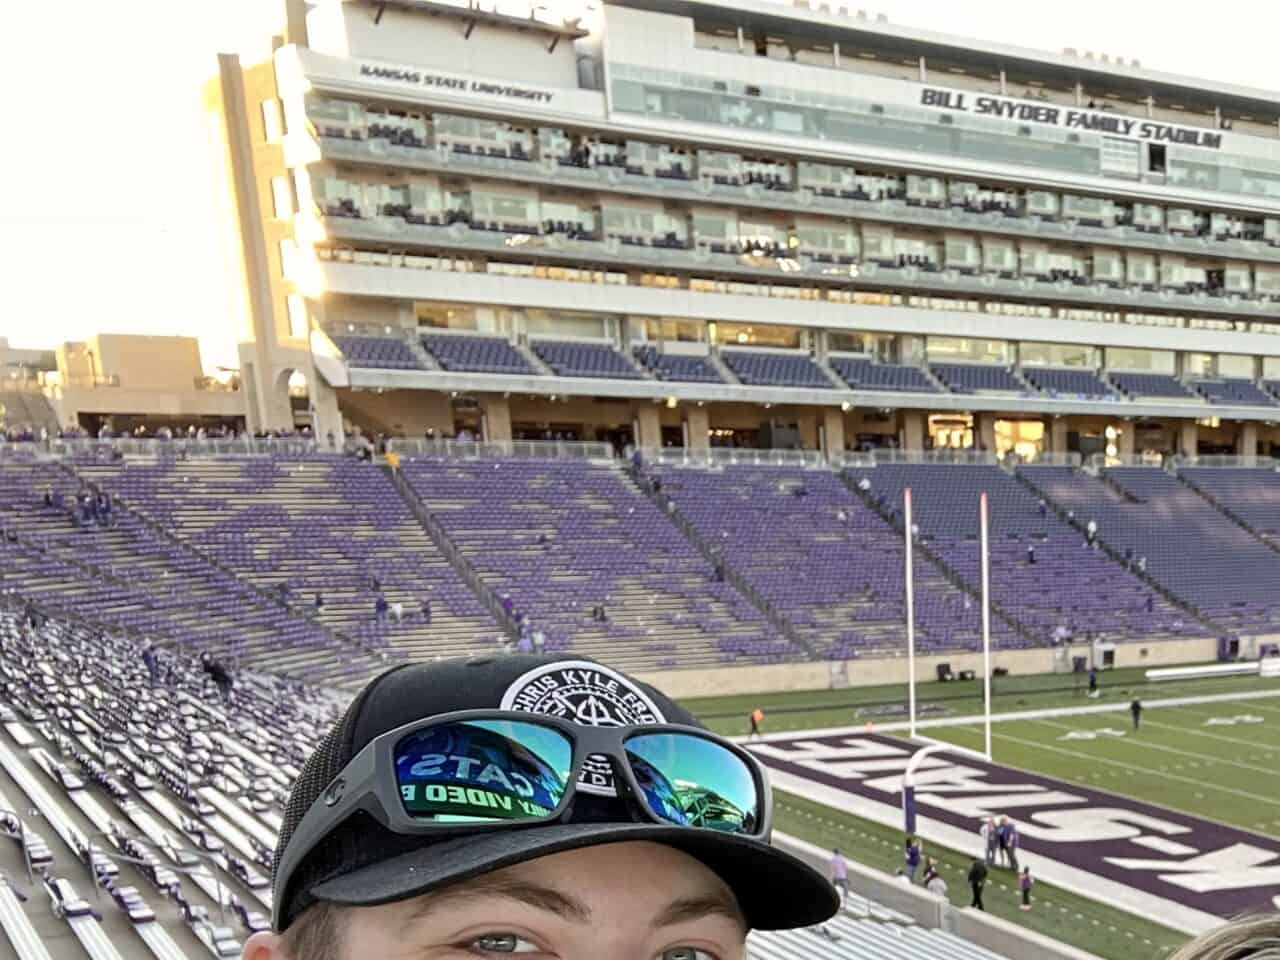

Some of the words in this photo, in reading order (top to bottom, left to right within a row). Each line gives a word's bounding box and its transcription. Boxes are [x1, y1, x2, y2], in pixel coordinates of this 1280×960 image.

[361, 64, 419, 84] KANSAS
[424, 75, 468, 90] STATE
[471, 82, 553, 103] UNIVERSITY
[921, 88, 967, 111] BILL
[974, 97, 1059, 124] SNYDER
[1066, 108, 1134, 135] FAMILY
[1139, 122, 1222, 148] STADIUM
[561, 669, 619, 694] KYLE
